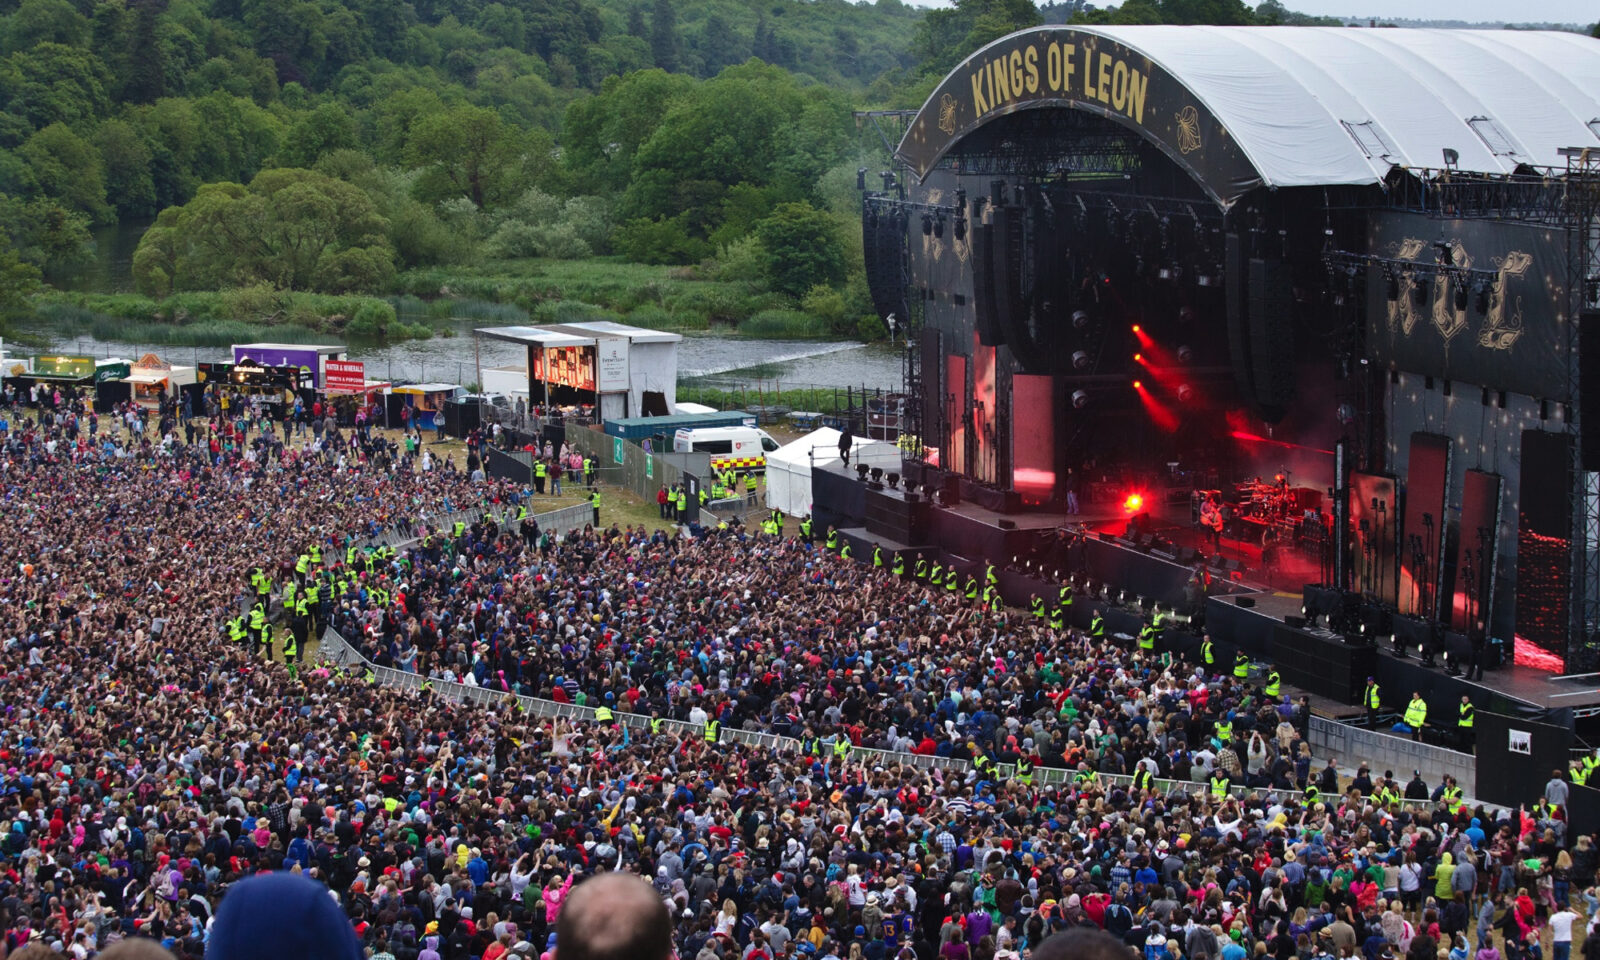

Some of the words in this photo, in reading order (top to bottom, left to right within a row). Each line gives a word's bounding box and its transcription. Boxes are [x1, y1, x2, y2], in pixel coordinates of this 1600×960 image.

[971, 45, 1039, 118] KINGS
[1048, 42, 1075, 91] OF
[1084, 47, 1147, 125] LEON
[344, 364, 363, 372] MINERALS
[907, 918, 913, 930] 7
[884, 925, 895, 936] 13
